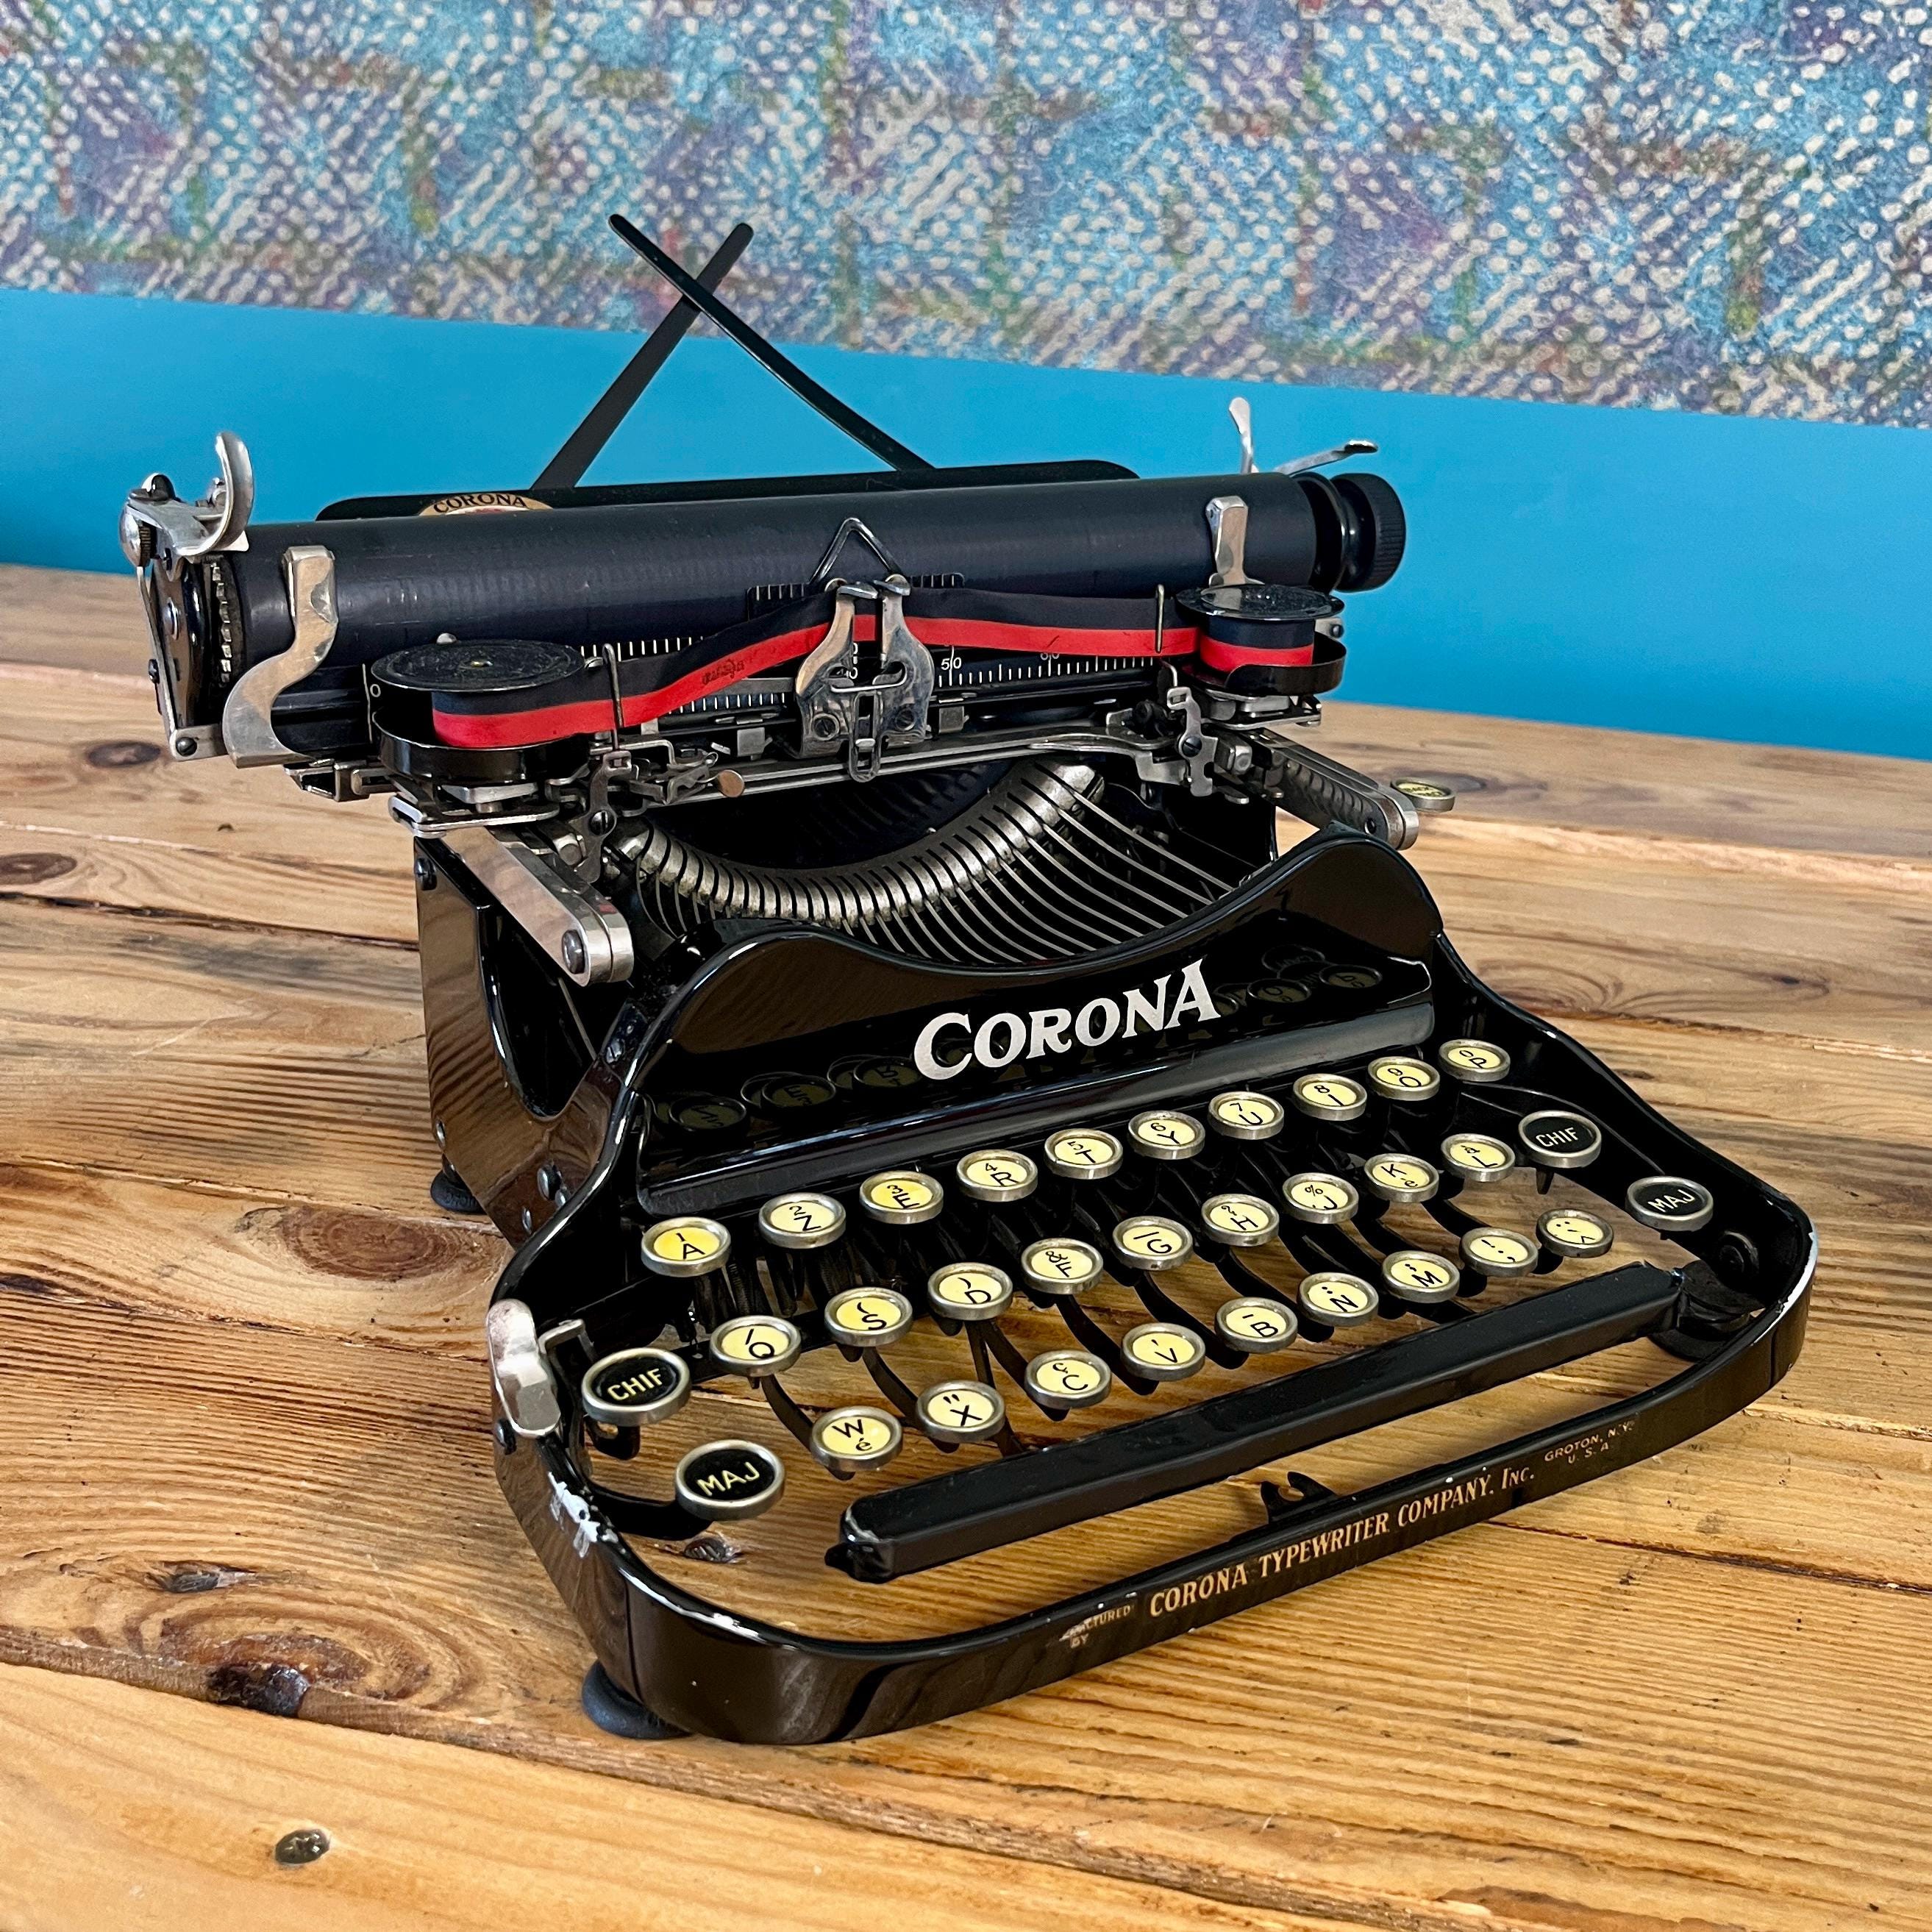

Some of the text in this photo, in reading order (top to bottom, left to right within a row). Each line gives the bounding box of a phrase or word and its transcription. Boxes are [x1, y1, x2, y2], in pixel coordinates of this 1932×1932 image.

[433, 493, 527, 513] CORONA
[913, 958, 1222, 1080] CORONA
[1468, 1057, 1486, 1069] P
[1387, 1068, 1403, 1077] 9
[1313, 1085, 1330, 1094] 8
[1399, 1076, 1422, 1088] O
[1230, 1102, 1243, 1112] 7
[1238, 1111, 1263, 1125] U
[1150, 1122, 1166, 1132] 6
[1157, 1131, 1180, 1144] Y
[1536, 1127, 1578, 1147] CHIF
[1067, 1141, 1084, 1150] 5
[1075, 1149, 1096, 1163] T
[1472, 1155, 1498, 1167] L
[985, 1163, 997, 1172] 4
[1381, 1163, 1406, 1177] K
[990, 1172, 1019, 1187] R
[887, 1184, 903, 1194] 3
[1305, 1184, 1324, 1197] %
[892, 1193, 919, 1209] E
[1312, 1195, 1339, 1211] J
[1647, 1188, 1694, 1213] MAJ
[789, 1205, 806, 1216] 2
[794, 1215, 822, 1231] Z
[1230, 1215, 1258, 1230] H
[675, 1233, 685, 1241] 1
[682, 1243, 705, 1259] A
[1147, 1238, 1172, 1254] G
[1045, 1250, 1068, 1263] &
[1055, 1261, 1072, 1277] F
[1411, 1271, 1443, 1287] M
[963, 1288, 991, 1303] D
[1330, 1294, 1358, 1312] N
[861, 1313, 887, 1331] S
[1250, 1322, 1278, 1339] B
[749, 1341, 775, 1359] Q
[1154, 1347, 1178, 1364] V
[607, 1368, 662, 1400] CHIF
[1062, 1374, 1088, 1390] C
[950, 1405, 983, 1427] X
[831, 1419, 863, 1437] W
[855, 1437, 872, 1452] é
[697, 1462, 760, 1496] MAJ
[1149, 1562, 1247, 1616] CORONA
[1258, 1512, 1390, 1578] TYPEWRITER
